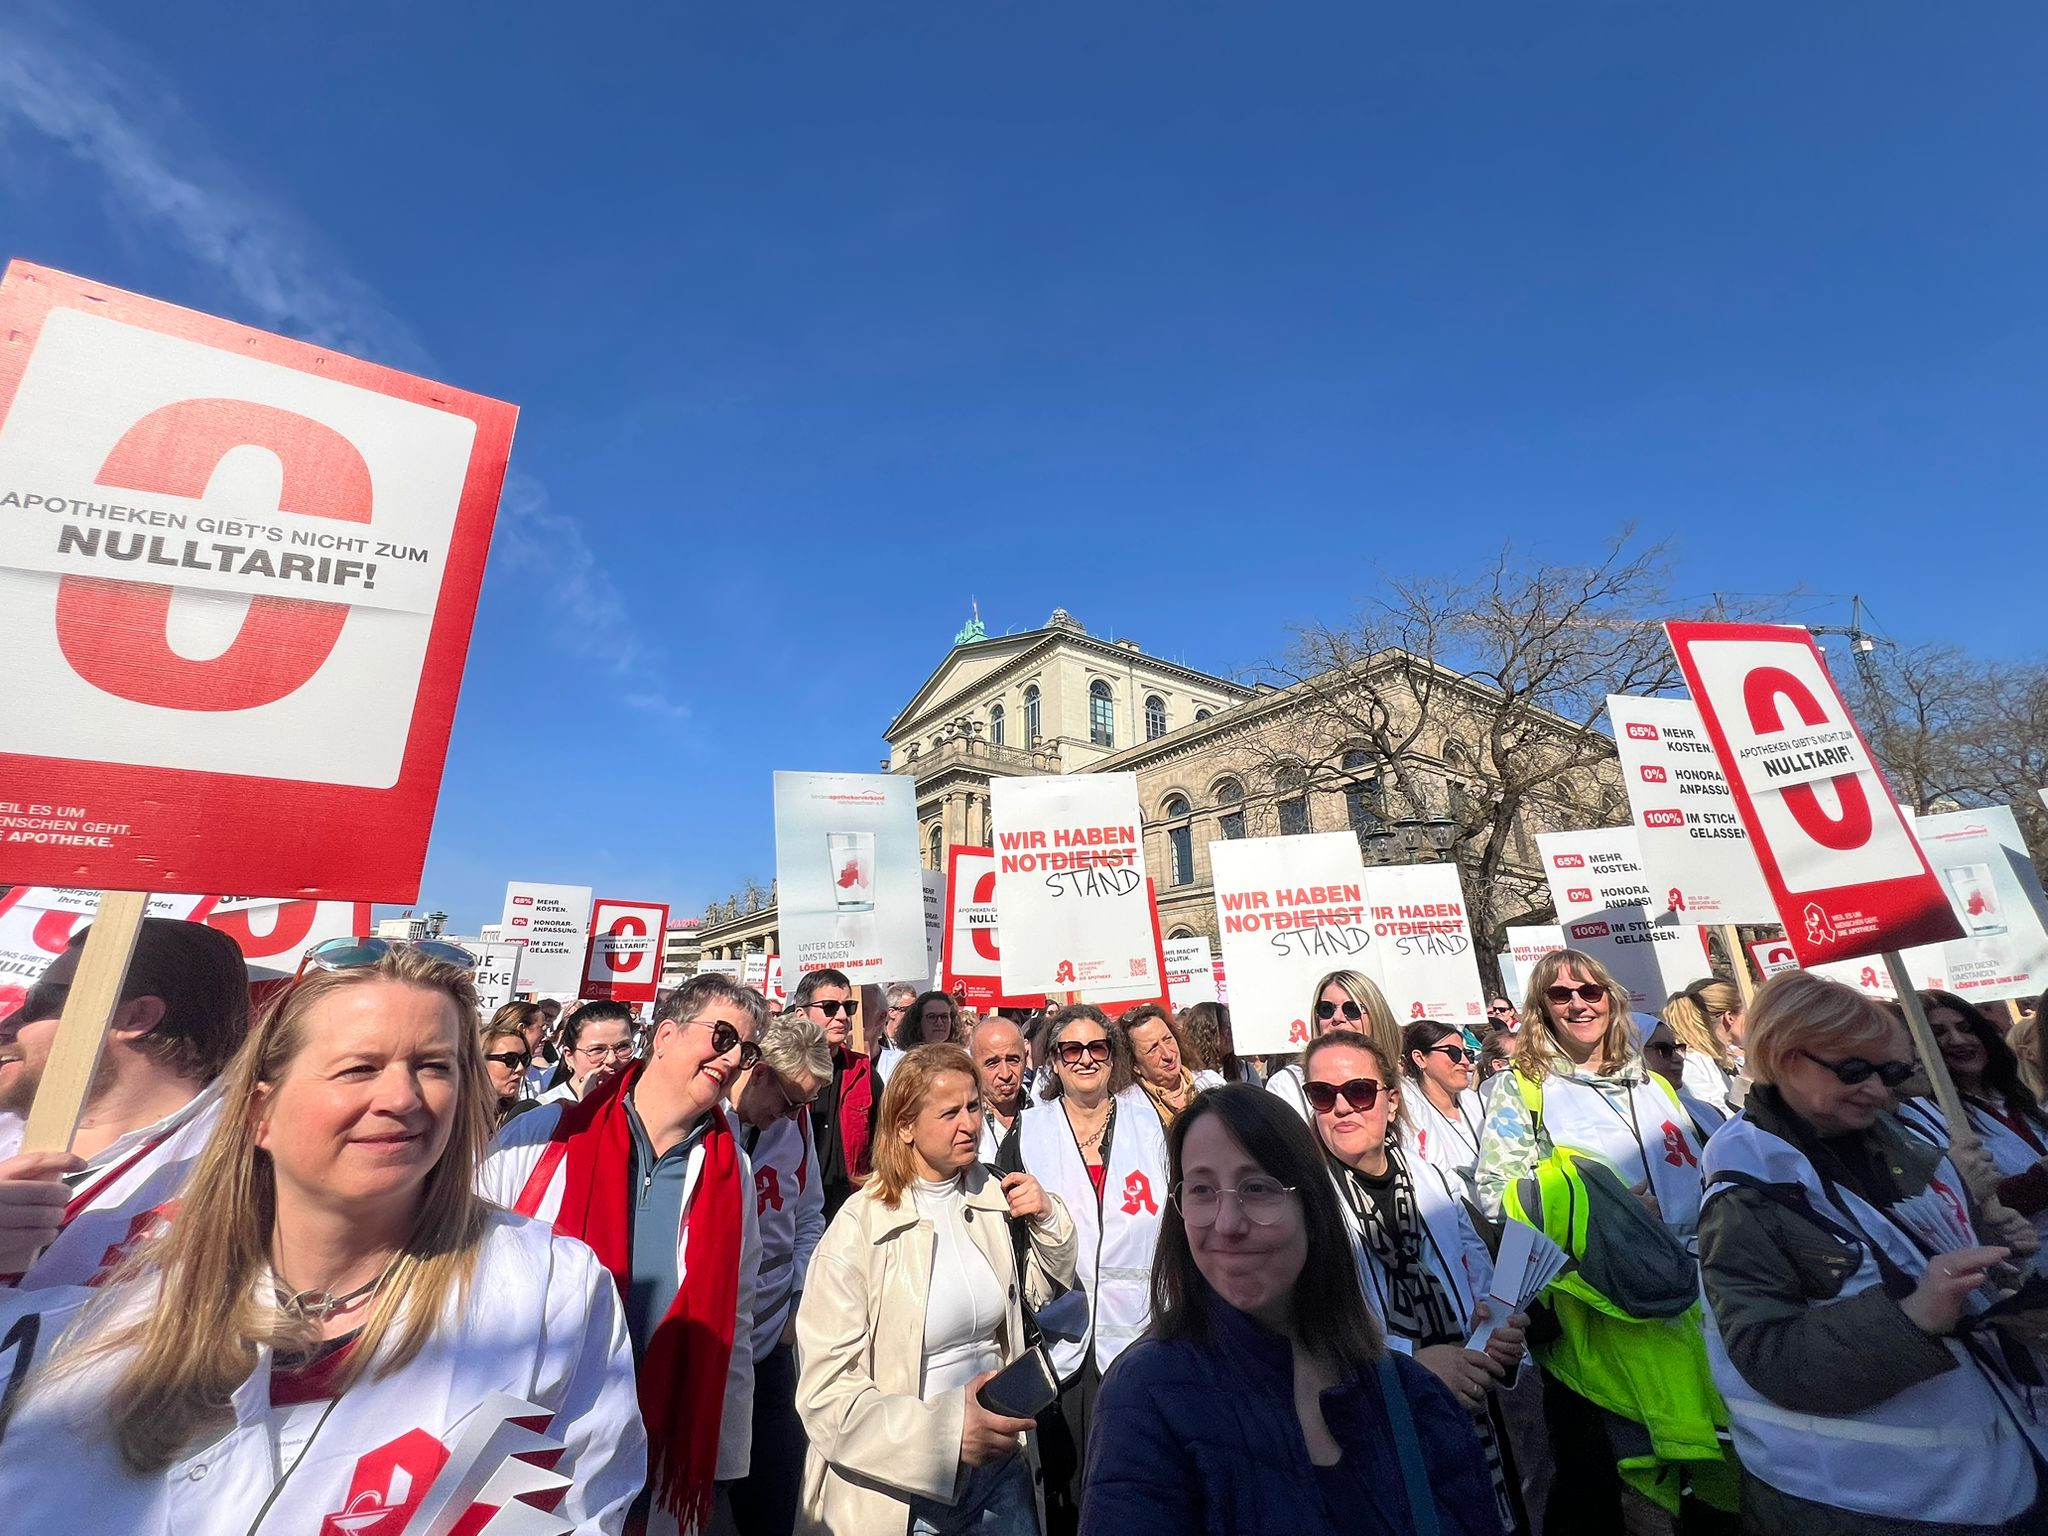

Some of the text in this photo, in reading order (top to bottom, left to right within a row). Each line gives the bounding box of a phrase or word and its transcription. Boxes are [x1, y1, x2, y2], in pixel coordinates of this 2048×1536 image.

[0, 491, 429, 563] APOTHEKEN GIBT'S NICHT ZUM
[57, 524, 377, 589] NULLTARIF!
[1629, 726, 1696, 739] 65% MEHR
[1667, 742, 1714, 753] KOSTEN.
[1739, 730, 1854, 759] APOTHEKEN GIBT'S NICHT ZUM
[1763, 745, 1854, 777] NULLTARIF!
[1644, 769, 1725, 781] 0% HONORA
[29, 804, 52, 816] ES
[57, 806, 86, 818] UM
[1647, 813, 1736, 824] 100% IM STICH
[82, 822, 131, 836] GEHT.
[8, 831, 114, 848] APOTHEKE.
[999, 826, 1135, 850] WIR HABEN
[1002, 848, 1137, 873] NOTDIENST
[1557, 853, 1623, 866] 65% MEHR
[1592, 863, 1641, 874] KOSTEN.
[1046, 863, 1140, 897] STAND
[58, 896, 81, 906] Ihre
[514, 896, 532, 904] 65%
[1221, 884, 1361, 911] WIR HABEN
[1571, 891, 1590, 900] 0%
[1400, 903, 1461, 918] HABEN
[969, 915, 998, 924] NULL
[1225, 906, 1364, 933] NOTDIENST
[1575, 926, 1607, 936] 100%
[1611, 923, 1625, 932] IM
[1271, 922, 1370, 956] STAND
[1396, 931, 1469, 956] STAND
[1615, 932, 1679, 944] GELASSEN.
[799, 940, 855, 952] UNTER DIESEN
[800, 958, 882, 972] LÖSEN WIR UNS AUF!
[1950, 964, 1973, 973] UNTER
